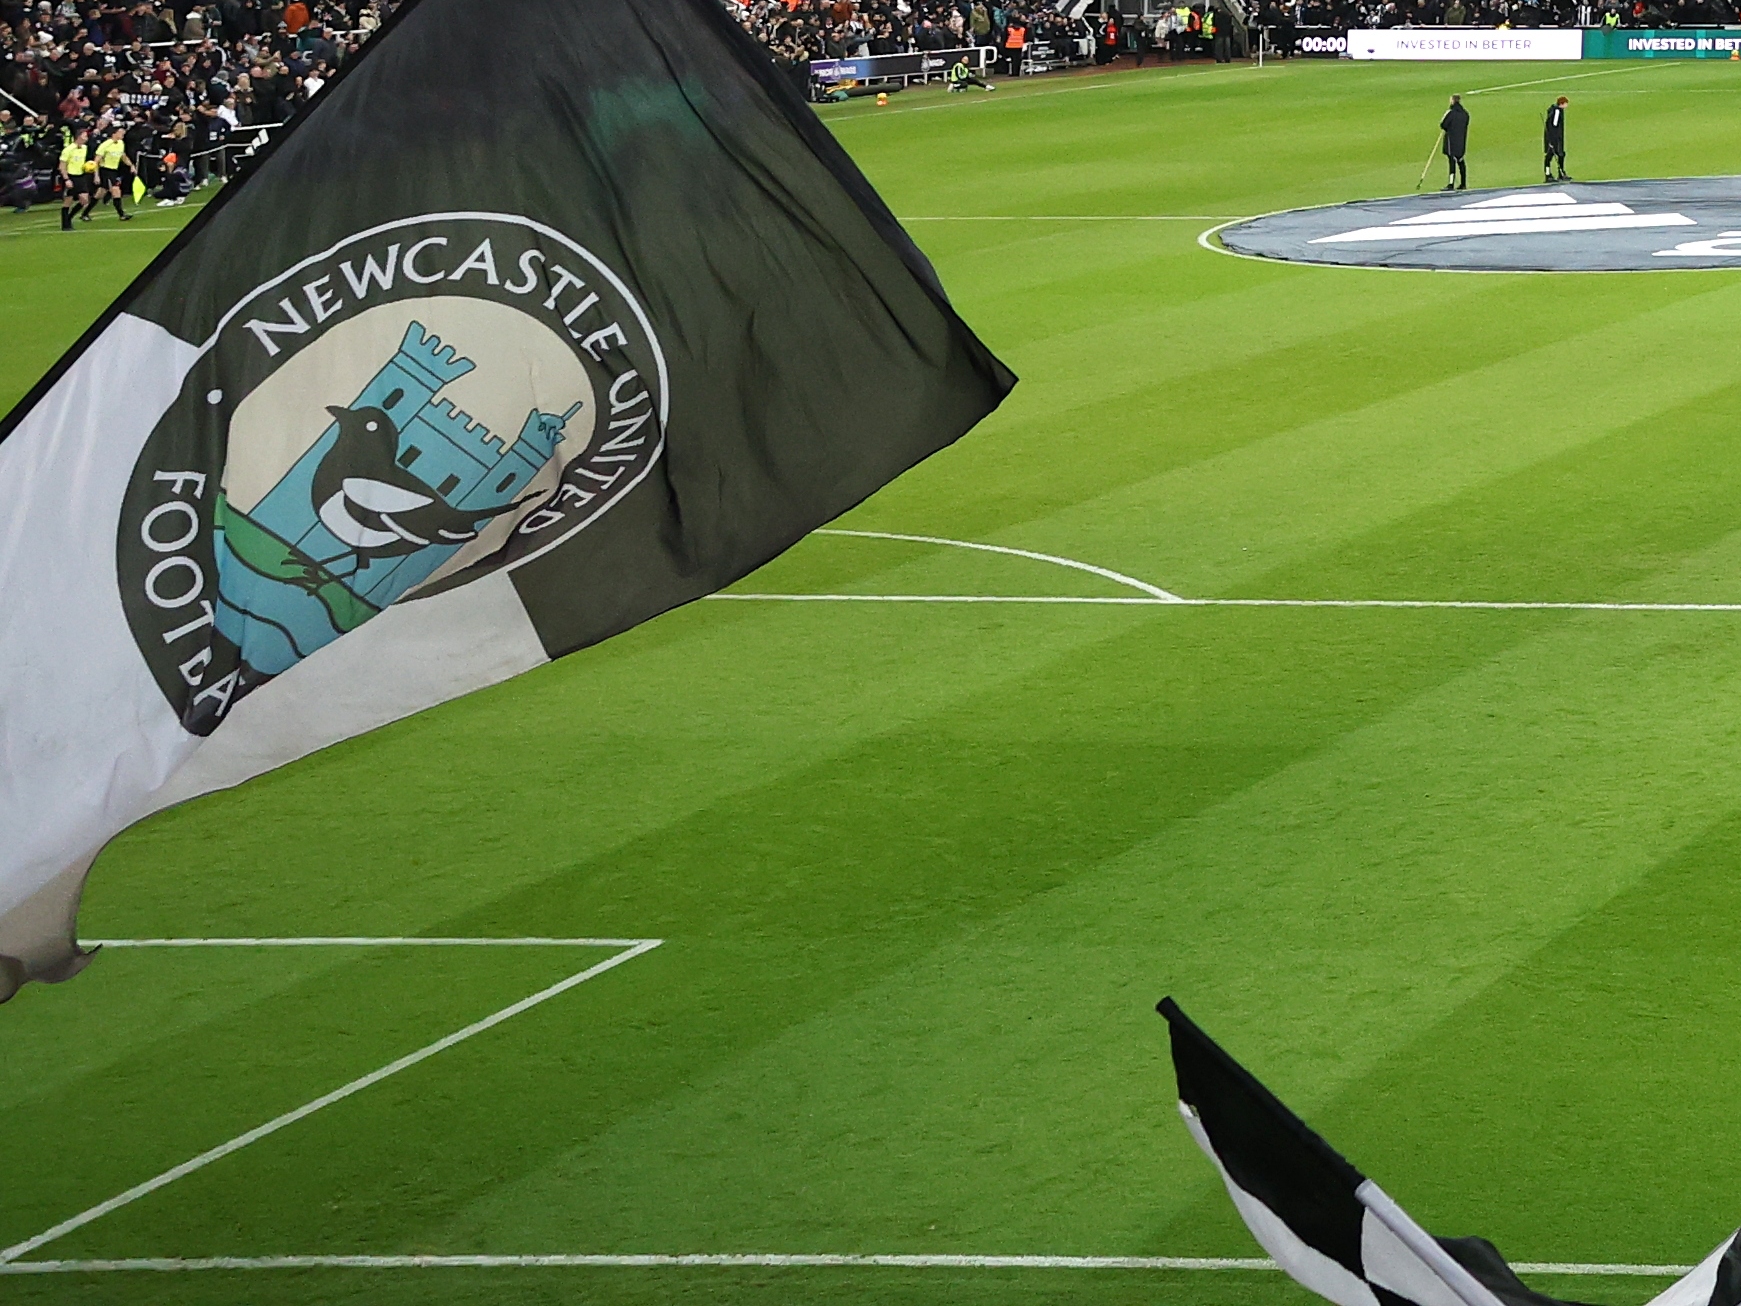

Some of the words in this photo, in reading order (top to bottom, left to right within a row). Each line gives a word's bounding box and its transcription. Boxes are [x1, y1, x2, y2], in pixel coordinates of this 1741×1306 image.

[1302, 37, 1346, 52] 00:00
[1396, 39, 1461, 50] INVESTED
[1465, 39, 1478, 50] IN
[1482, 39, 1531, 50] BETTER
[1628, 38, 1695, 51] INVESTED
[1697, 38, 1711, 51] IN
[242, 236, 628, 363] NEWCASTLE
[519, 369, 653, 534] UNITED
